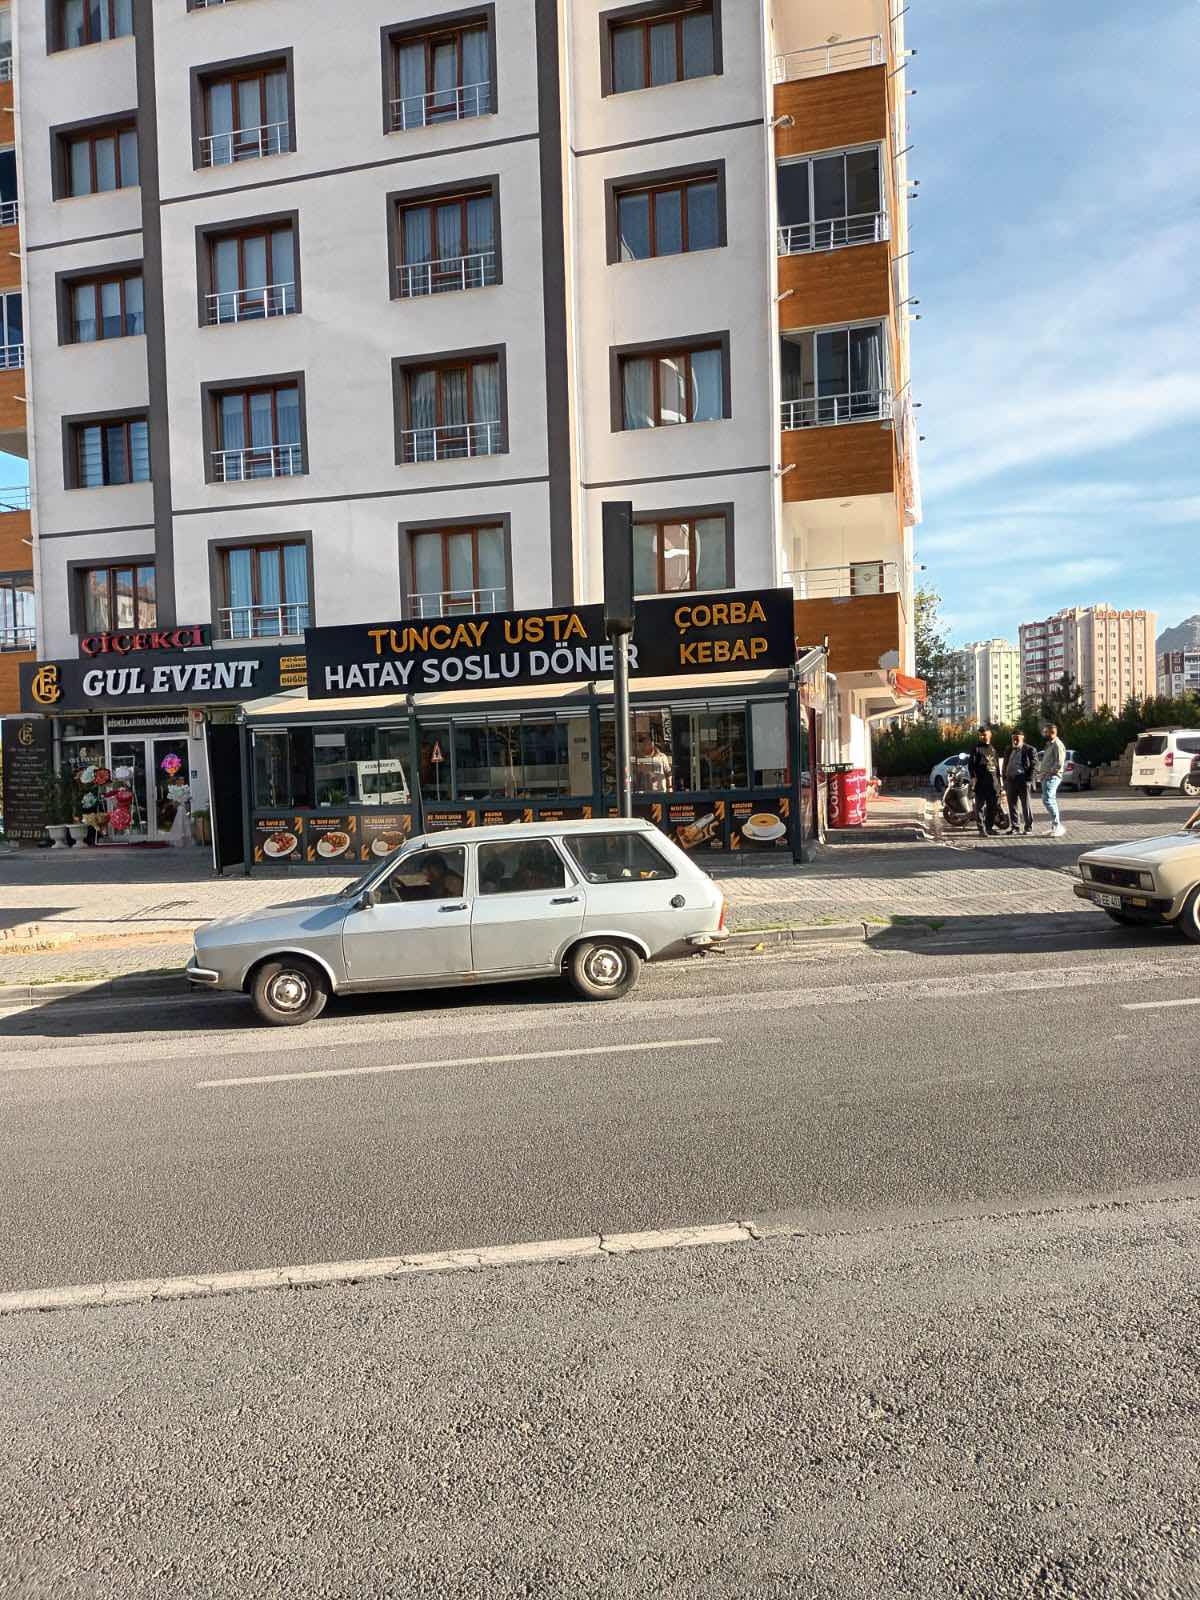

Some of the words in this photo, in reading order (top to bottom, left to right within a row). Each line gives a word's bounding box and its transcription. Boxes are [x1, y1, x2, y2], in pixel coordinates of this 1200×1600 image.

[368, 621, 488, 655] TUNCAY
[504, 613, 588, 644] USTA
[674, 600, 767, 634] ÇORBA
[325, 660, 415, 690] HATAY
[422, 652, 520, 684] SOSLU
[529, 641, 639, 677] DÖNER
[680, 637, 768, 664] KEBAP
[83, 667, 146, 697] GUL
[151, 660, 259, 693] EVENT
[829, 779, 840, 819] Cola
